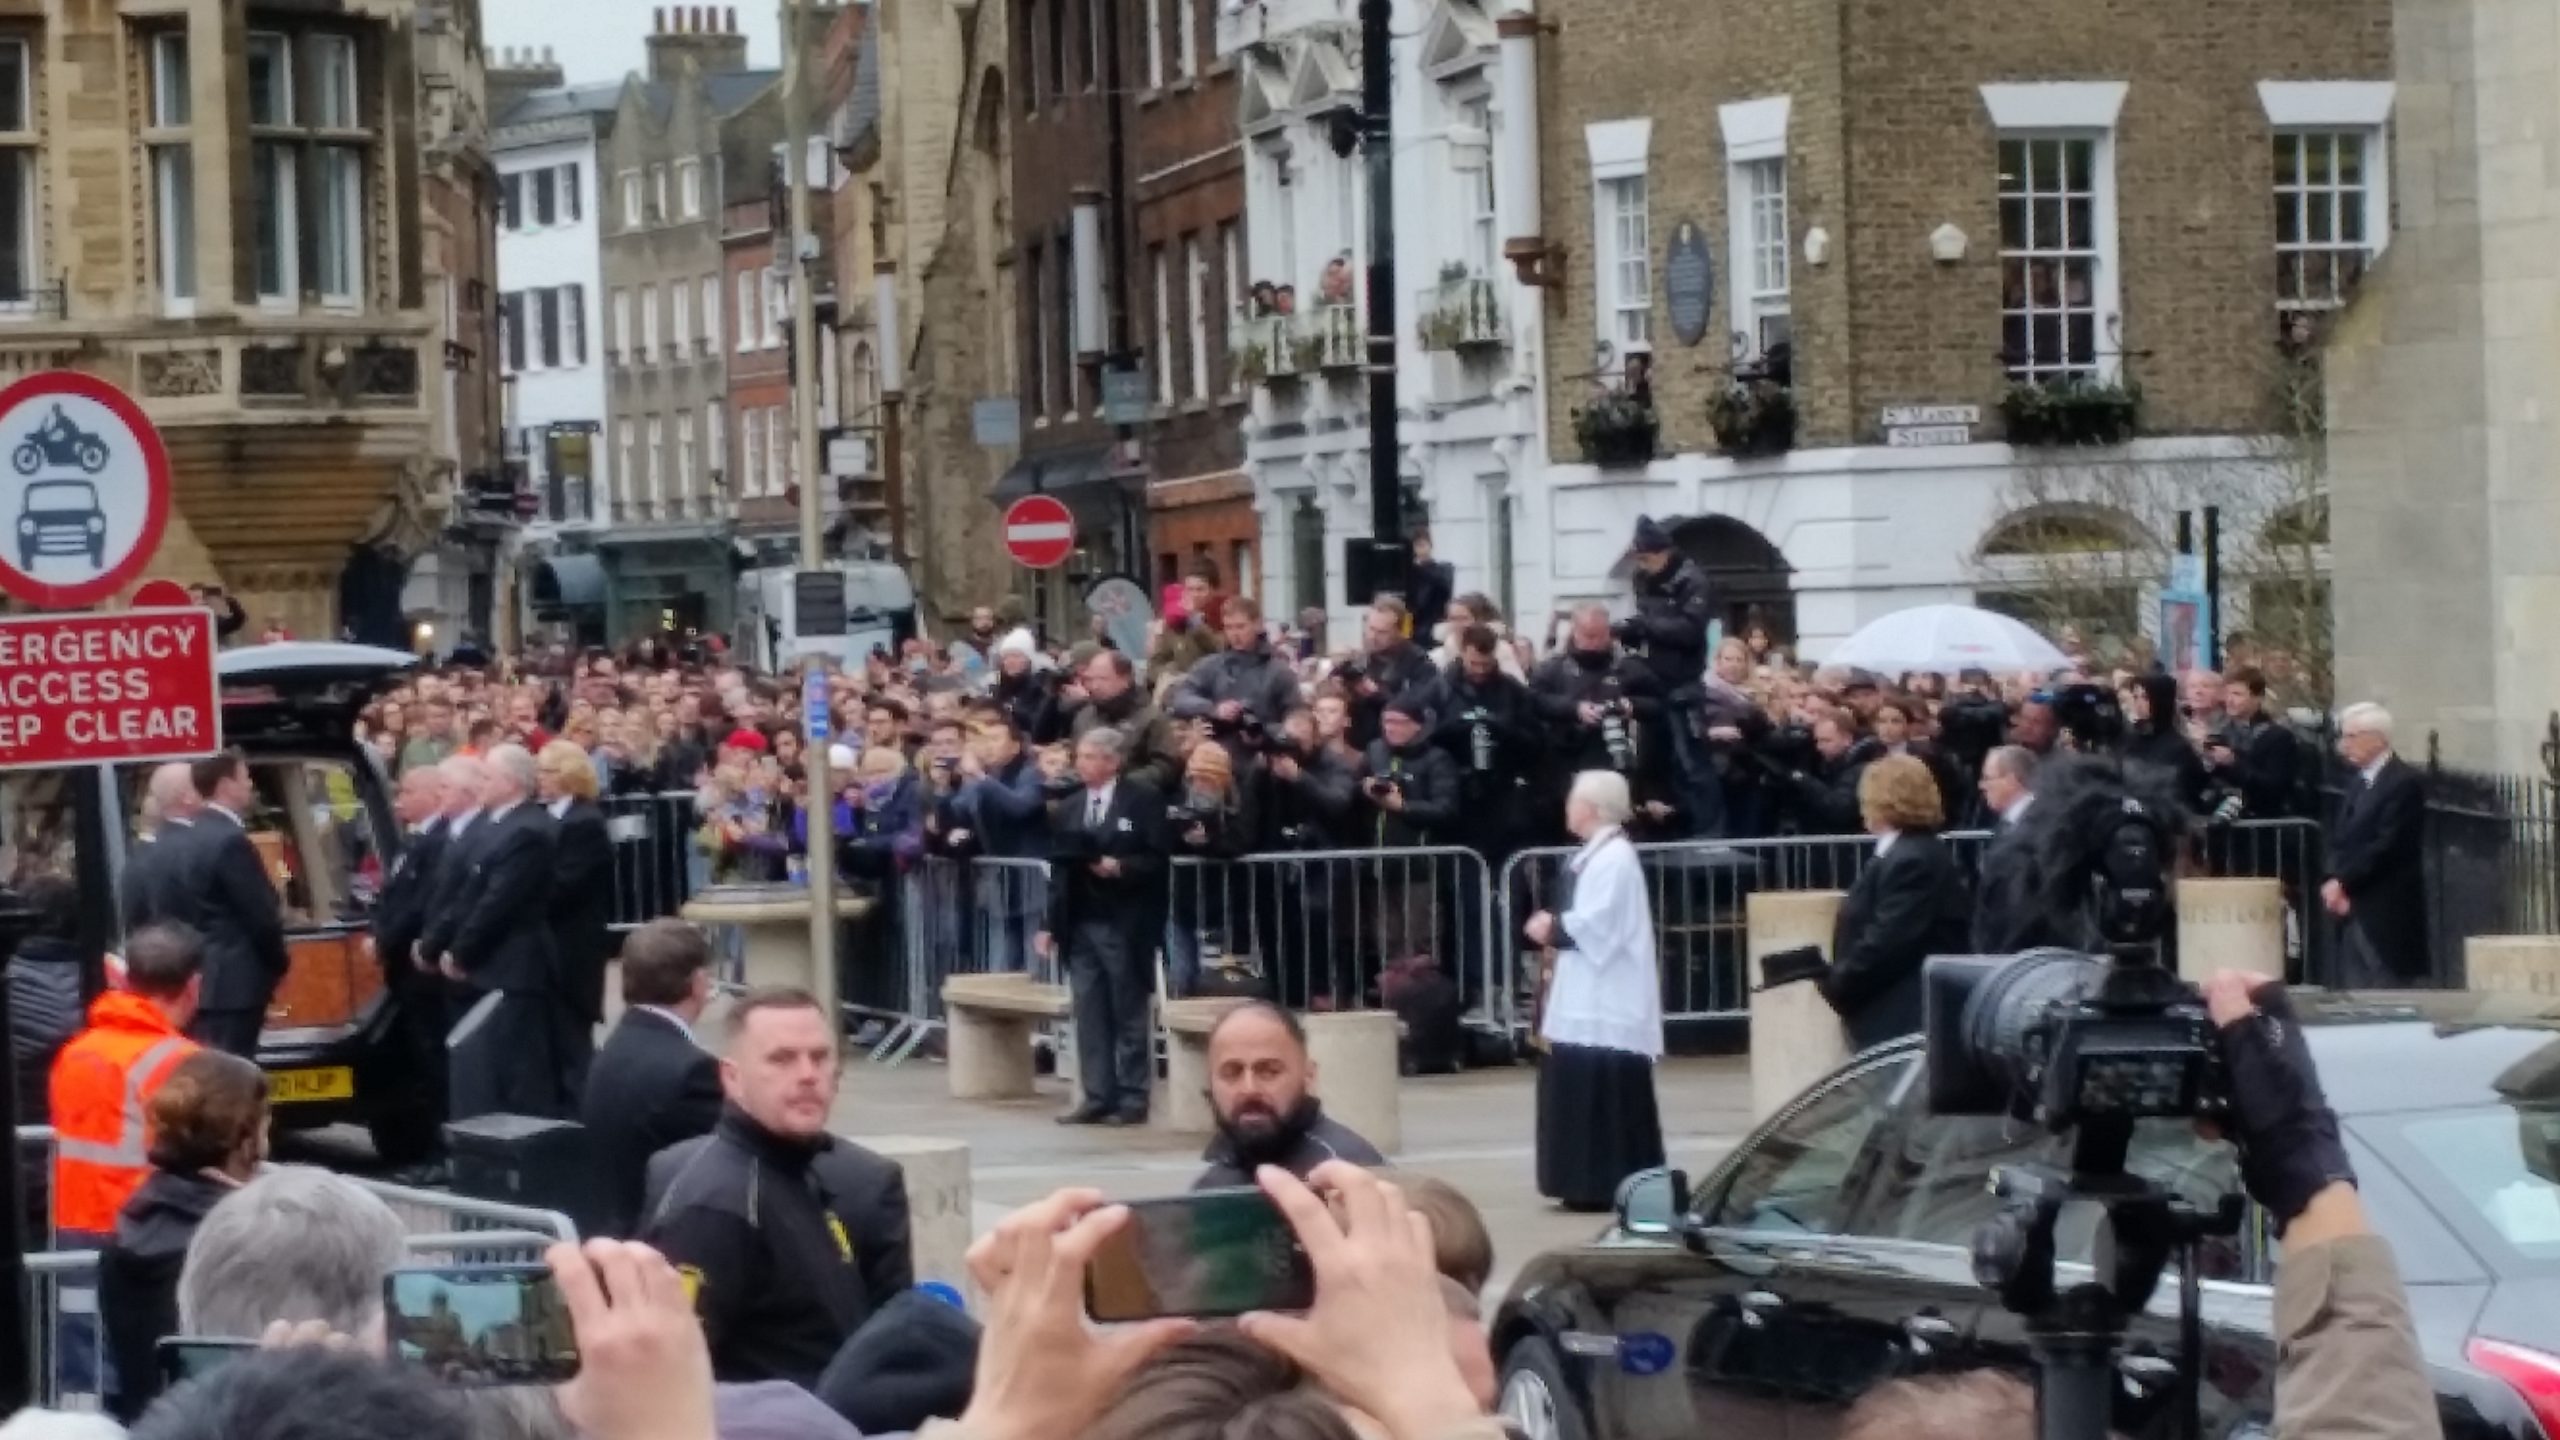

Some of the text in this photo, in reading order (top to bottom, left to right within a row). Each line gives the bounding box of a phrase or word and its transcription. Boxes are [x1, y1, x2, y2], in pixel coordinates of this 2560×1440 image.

[1897, 430, 1967, 447] STREET
[0, 667, 151, 708] CCESS
[65, 705, 199, 744] CLEAR
